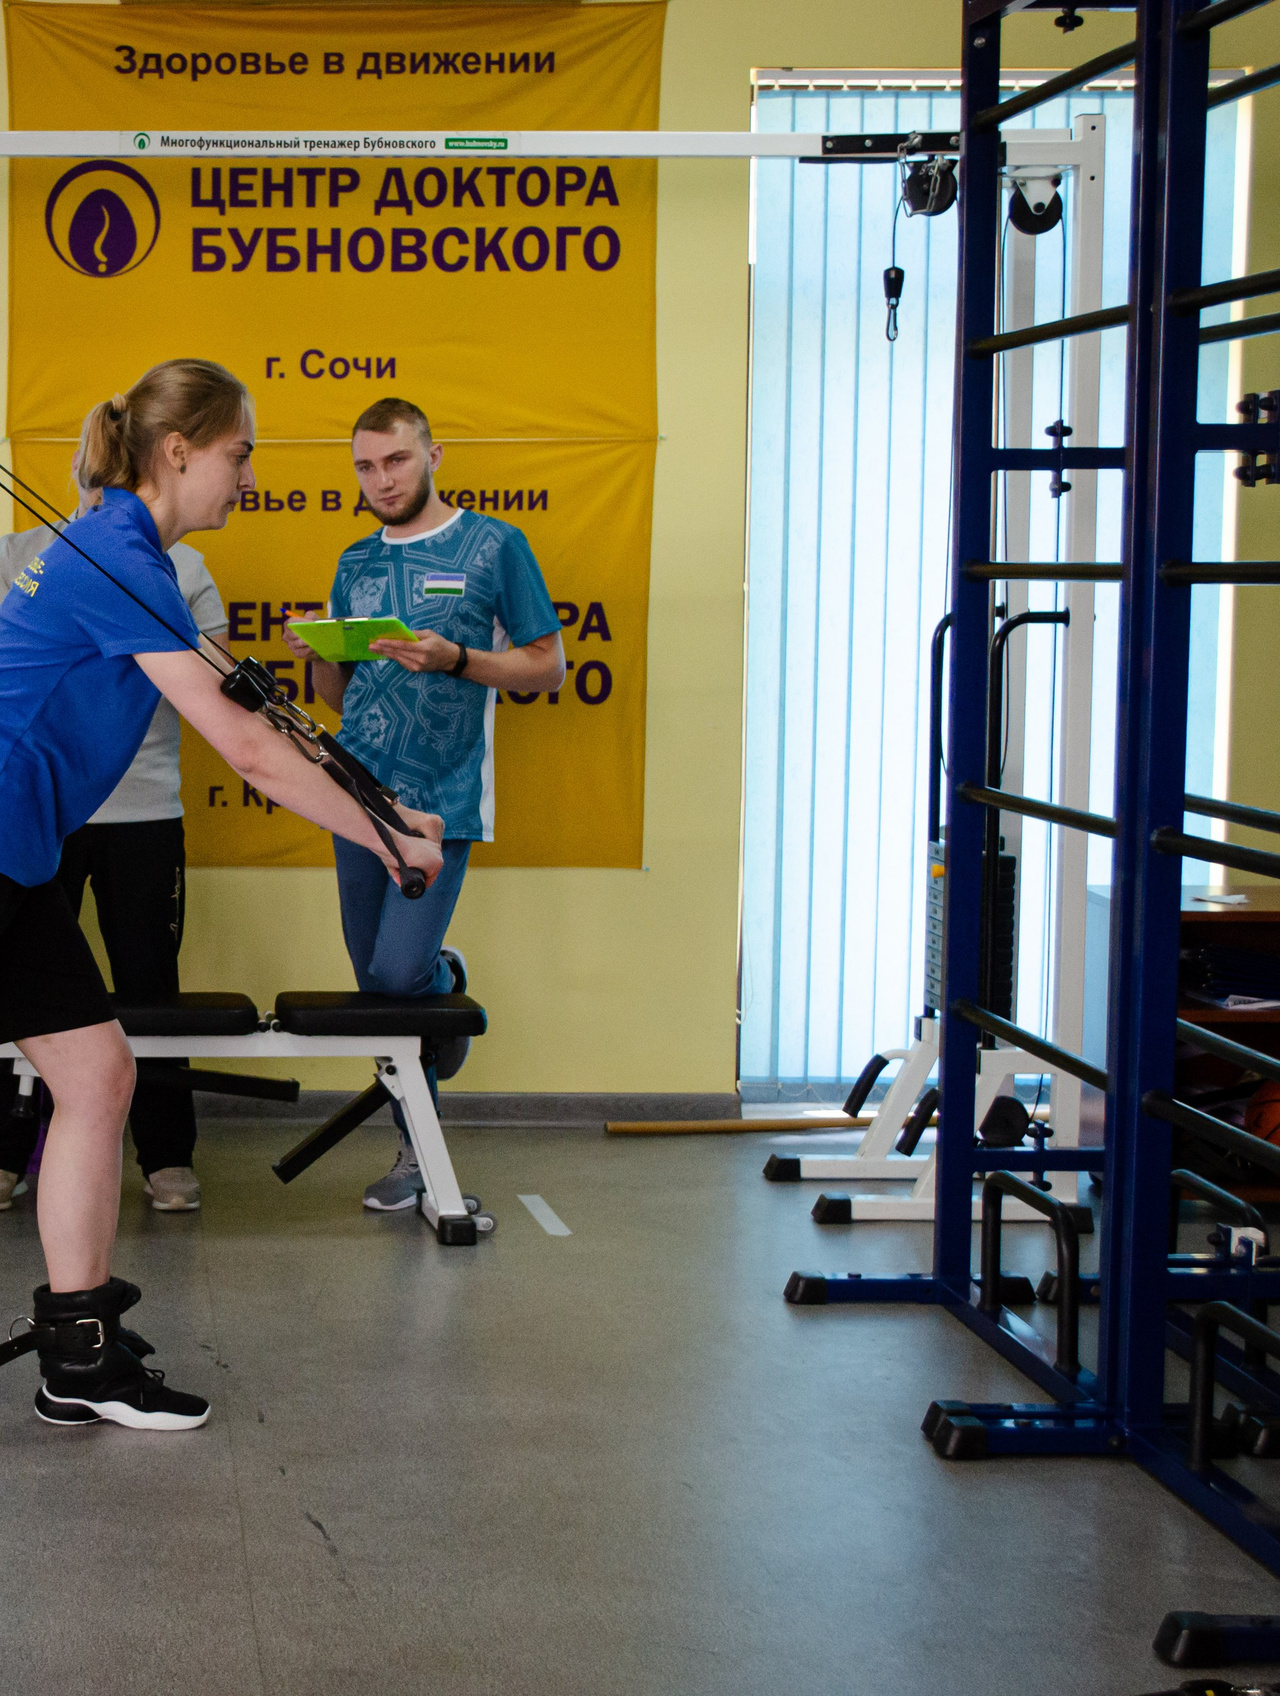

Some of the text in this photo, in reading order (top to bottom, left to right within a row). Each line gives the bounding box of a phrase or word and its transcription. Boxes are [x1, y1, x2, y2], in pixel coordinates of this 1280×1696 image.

[115, 45, 555, 81] Здоровье в движении
[160, 135, 436, 152] Многофункциональный тренажер Бубновского
[190, 165, 620, 216] ЦЕНТР ДОКТОРА
[191, 225, 621, 273] БУБНОВСКОГО
[266, 348, 396, 379] г. Сочи
[321, 490, 342, 512] в
[208, 786, 228, 807] г.
